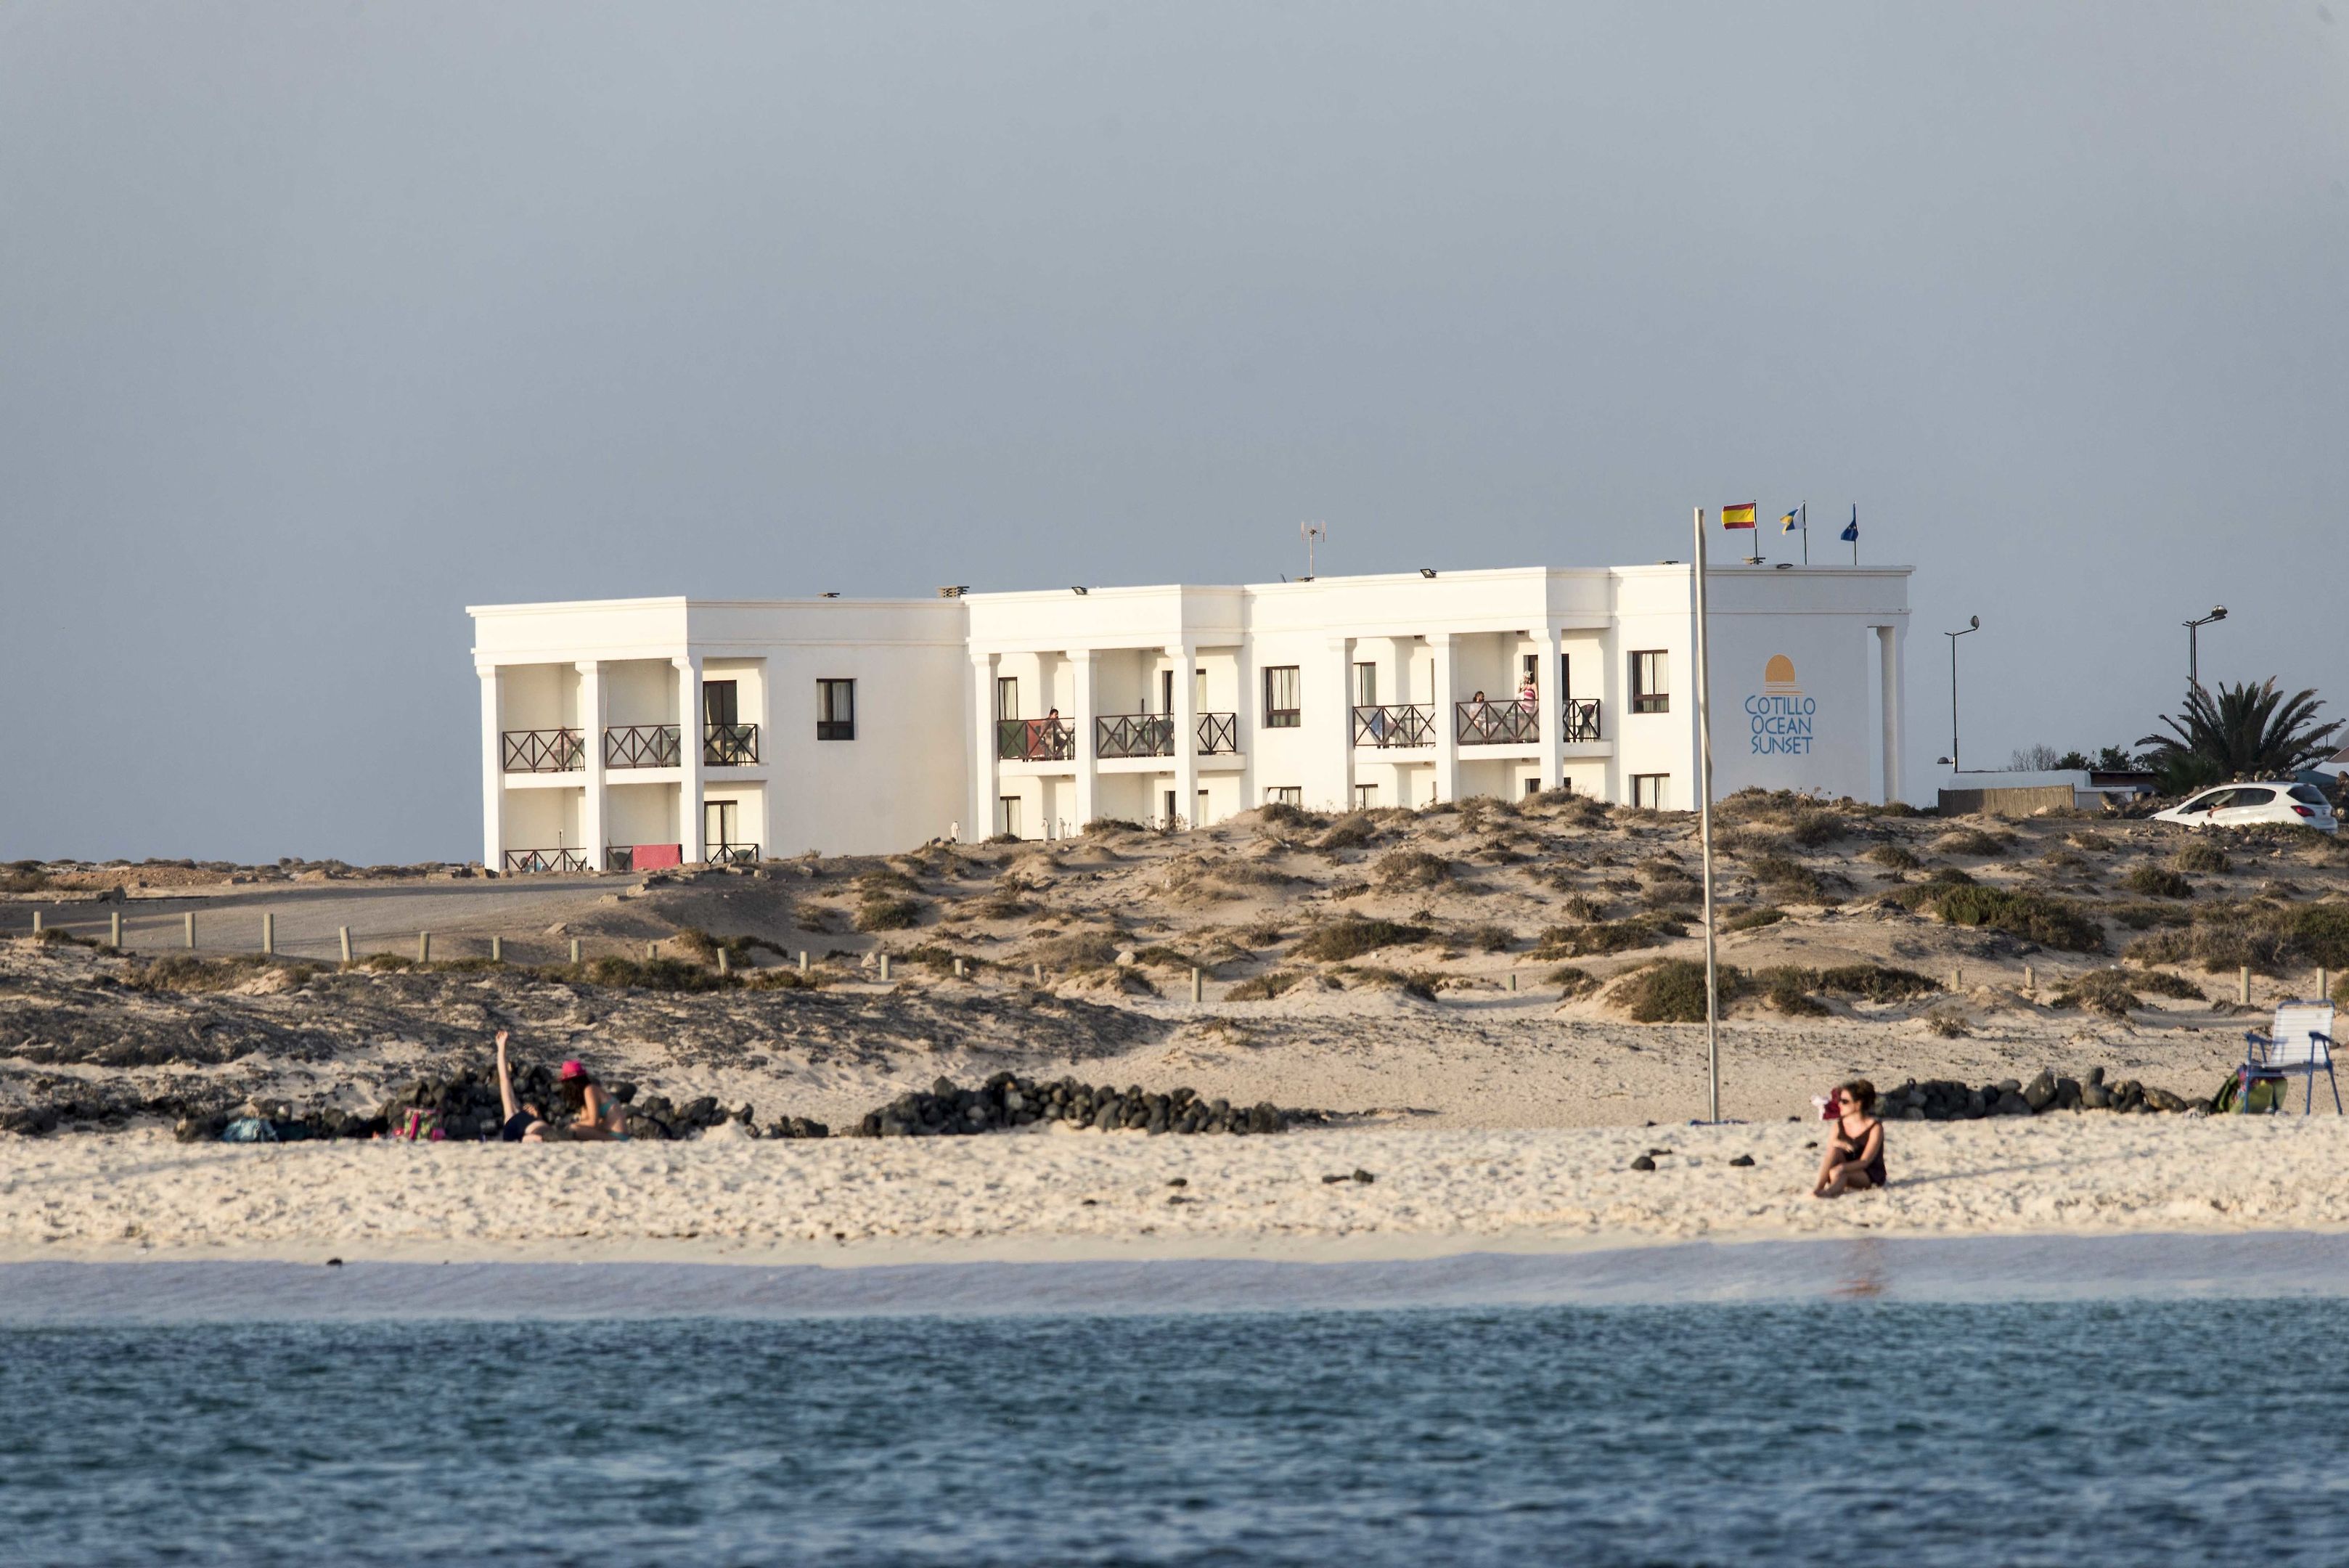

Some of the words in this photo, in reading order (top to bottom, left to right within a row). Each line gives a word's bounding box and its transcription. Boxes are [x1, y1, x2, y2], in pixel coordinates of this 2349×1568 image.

[1745, 695, 1815, 715] COTILLO
[1752, 715, 1811, 735] OCEAN
[1751, 735, 1813, 754] SUNSET
